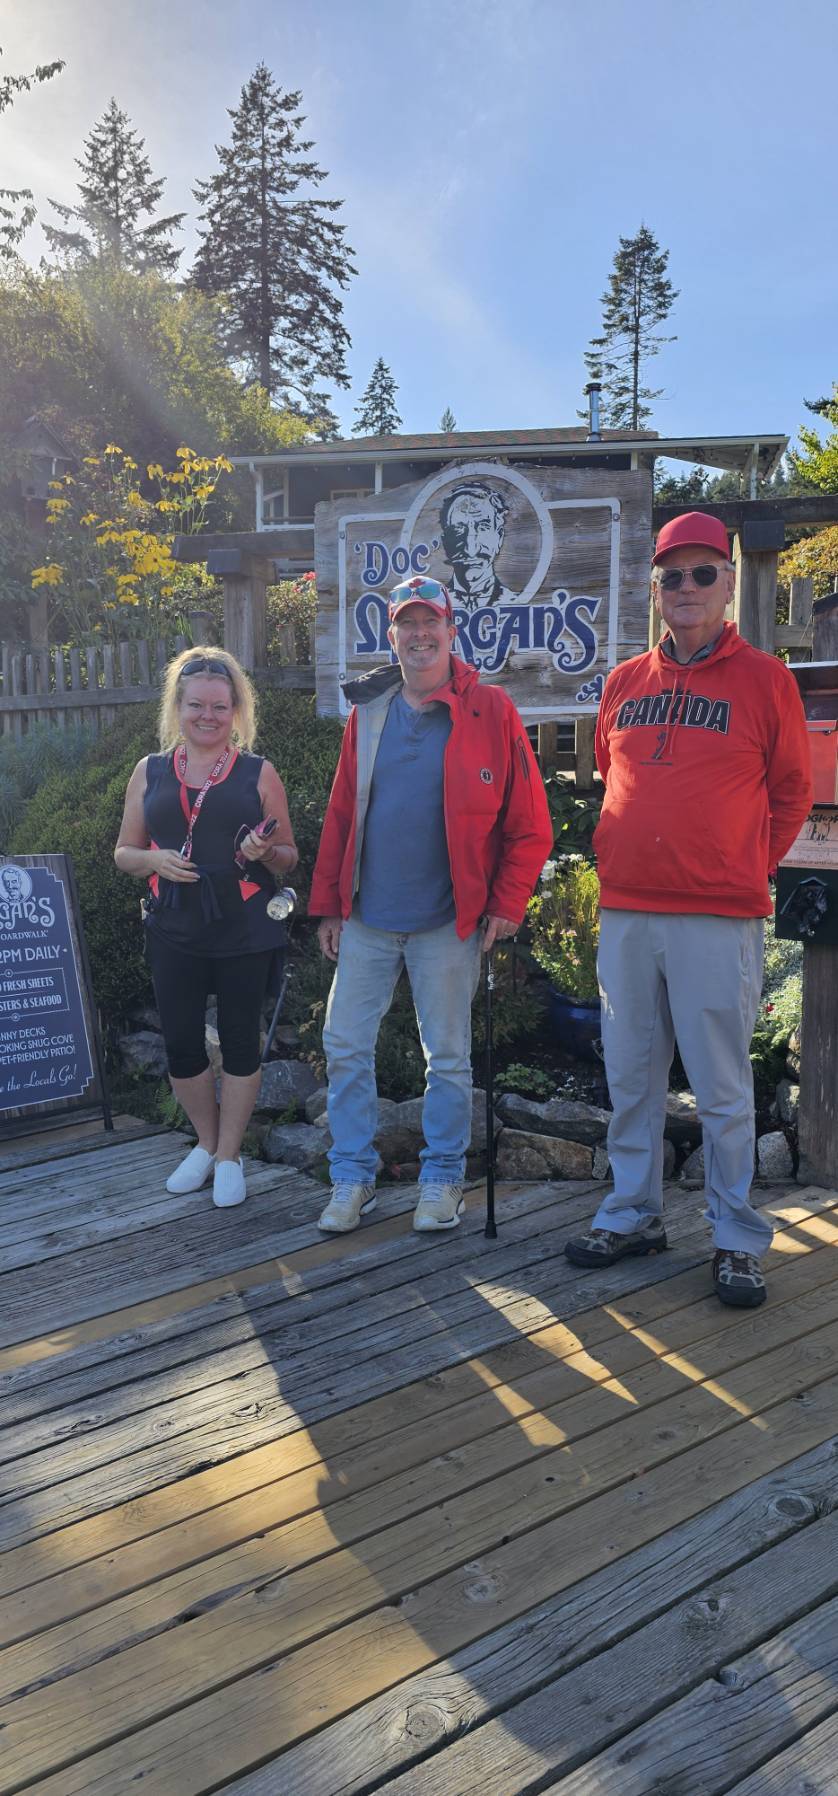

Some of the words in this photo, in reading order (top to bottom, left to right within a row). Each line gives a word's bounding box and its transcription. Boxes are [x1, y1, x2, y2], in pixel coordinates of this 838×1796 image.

[354, 588, 601, 674] MRGAN'S
[616, 694, 731, 735] CANADA
[24, 944, 61, 961] DAILY
[2, 979, 27, 992] FRESH
[27, 976, 55, 989] SHEETS
[22, 998, 30, 1009] &
[29, 994, 62, 1008] SEAFOOD
[18, 1026, 46, 1039] DECKS
[27, 1037, 50, 1049] SNUG
[50, 1033, 74, 1046] COVE
[7, 1075, 21, 1092] the
[23, 1070, 57, 1089] Locals
[58, 1063, 77, 1087] Go!
